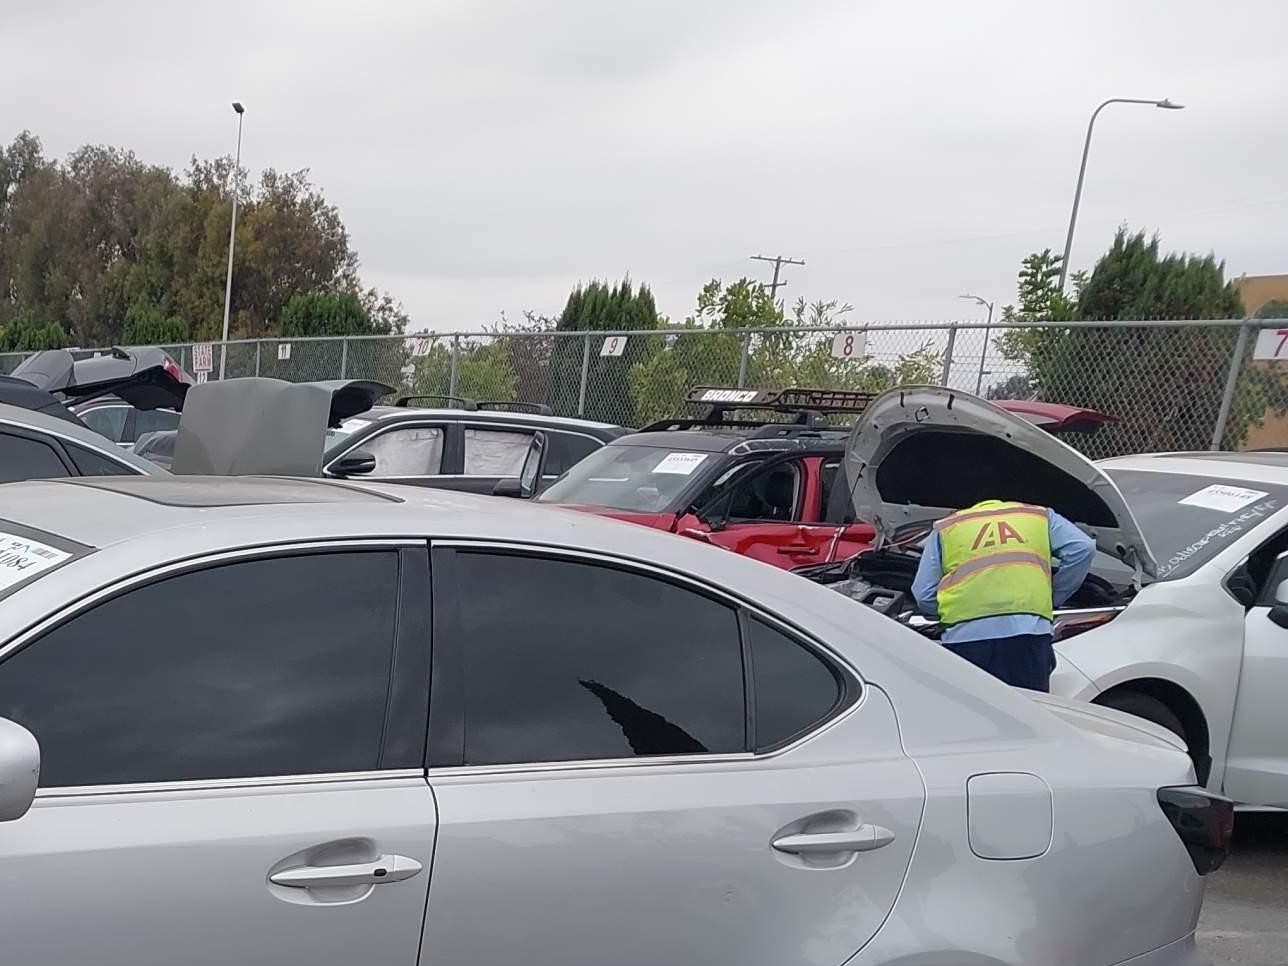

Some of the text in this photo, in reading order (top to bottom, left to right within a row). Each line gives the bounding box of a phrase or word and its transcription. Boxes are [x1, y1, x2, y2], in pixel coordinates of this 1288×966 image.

[194, 344, 211, 355] STATE
[417, 340, 429, 354] 10
[611, 338, 619, 353] 9
[843, 335, 854, 356] 8
[1275, 330, 1288, 357] 7
[281, 345, 288, 358] 11
[195, 356, 211, 368] FARM
[701, 390, 758, 402] BRONCO
